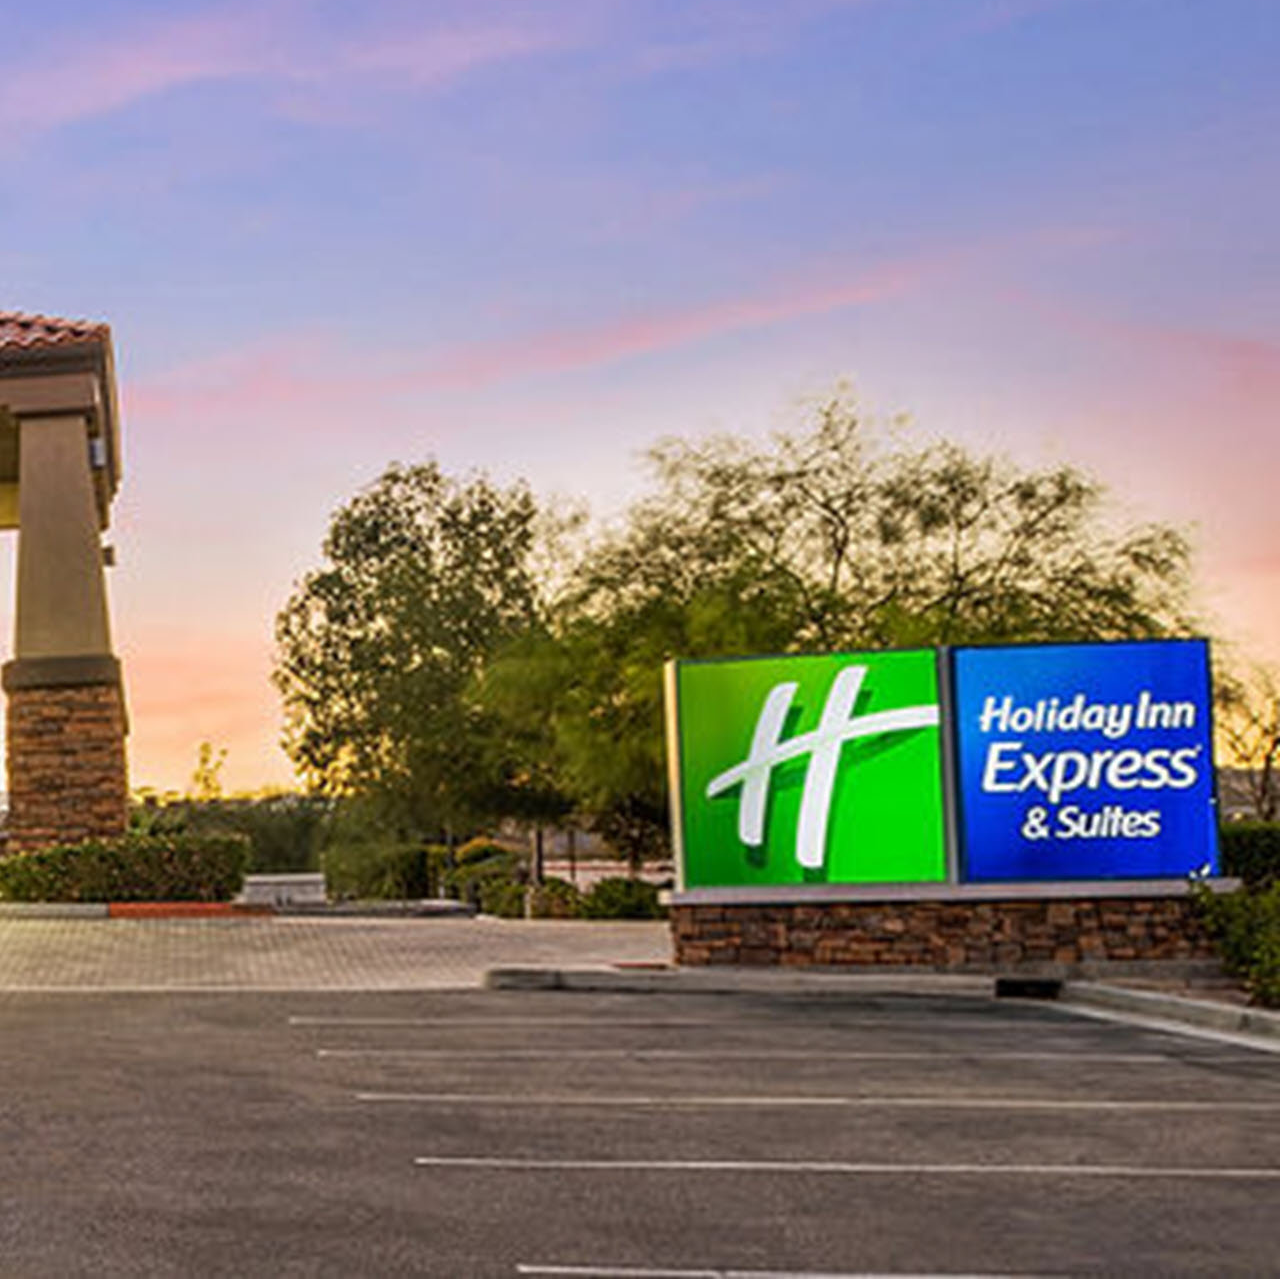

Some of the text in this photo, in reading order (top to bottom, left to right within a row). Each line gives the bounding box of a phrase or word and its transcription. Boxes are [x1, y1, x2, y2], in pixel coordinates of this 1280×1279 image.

[979, 690, 1197, 739] Holiday Inn
[981, 741, 1199, 805] Express
[1021, 805, 1162, 840] & Suites
